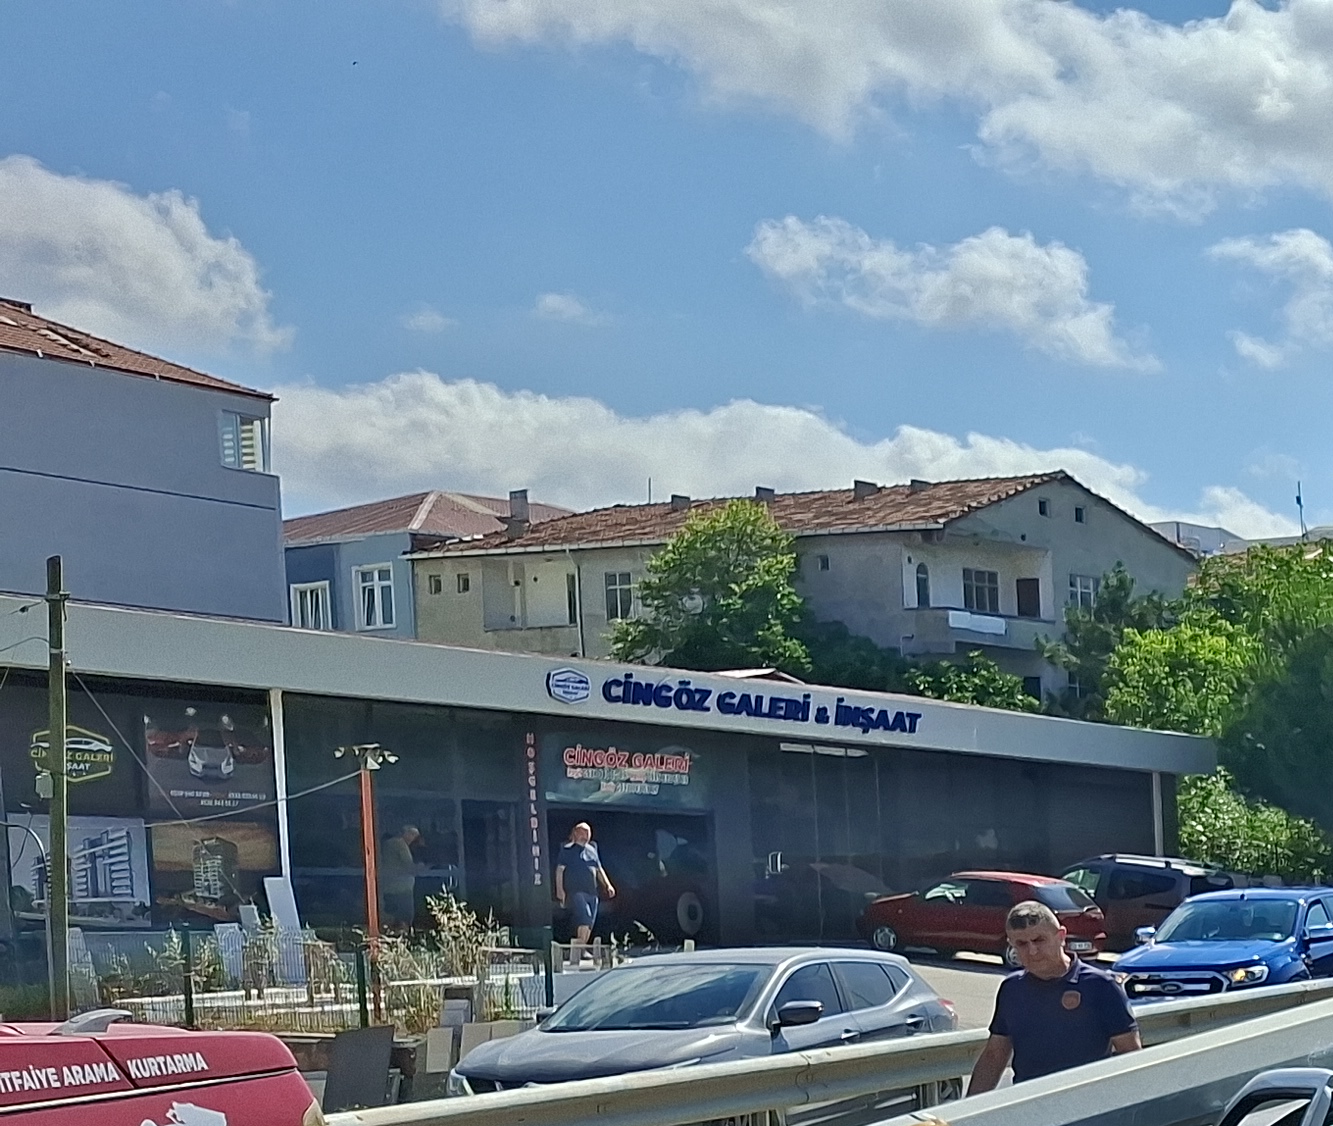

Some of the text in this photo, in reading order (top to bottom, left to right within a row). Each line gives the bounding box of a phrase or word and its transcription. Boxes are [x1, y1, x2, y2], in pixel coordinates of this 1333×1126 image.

[602, 673, 922, 734] CİNGÖZ GALERİ & İNŞAAT
[563, 744, 689, 773] CİNGÖZ GALERİ
[62, 1062, 120, 1087] ARAMA
[127, 1052, 209, 1079] KURTARMA
